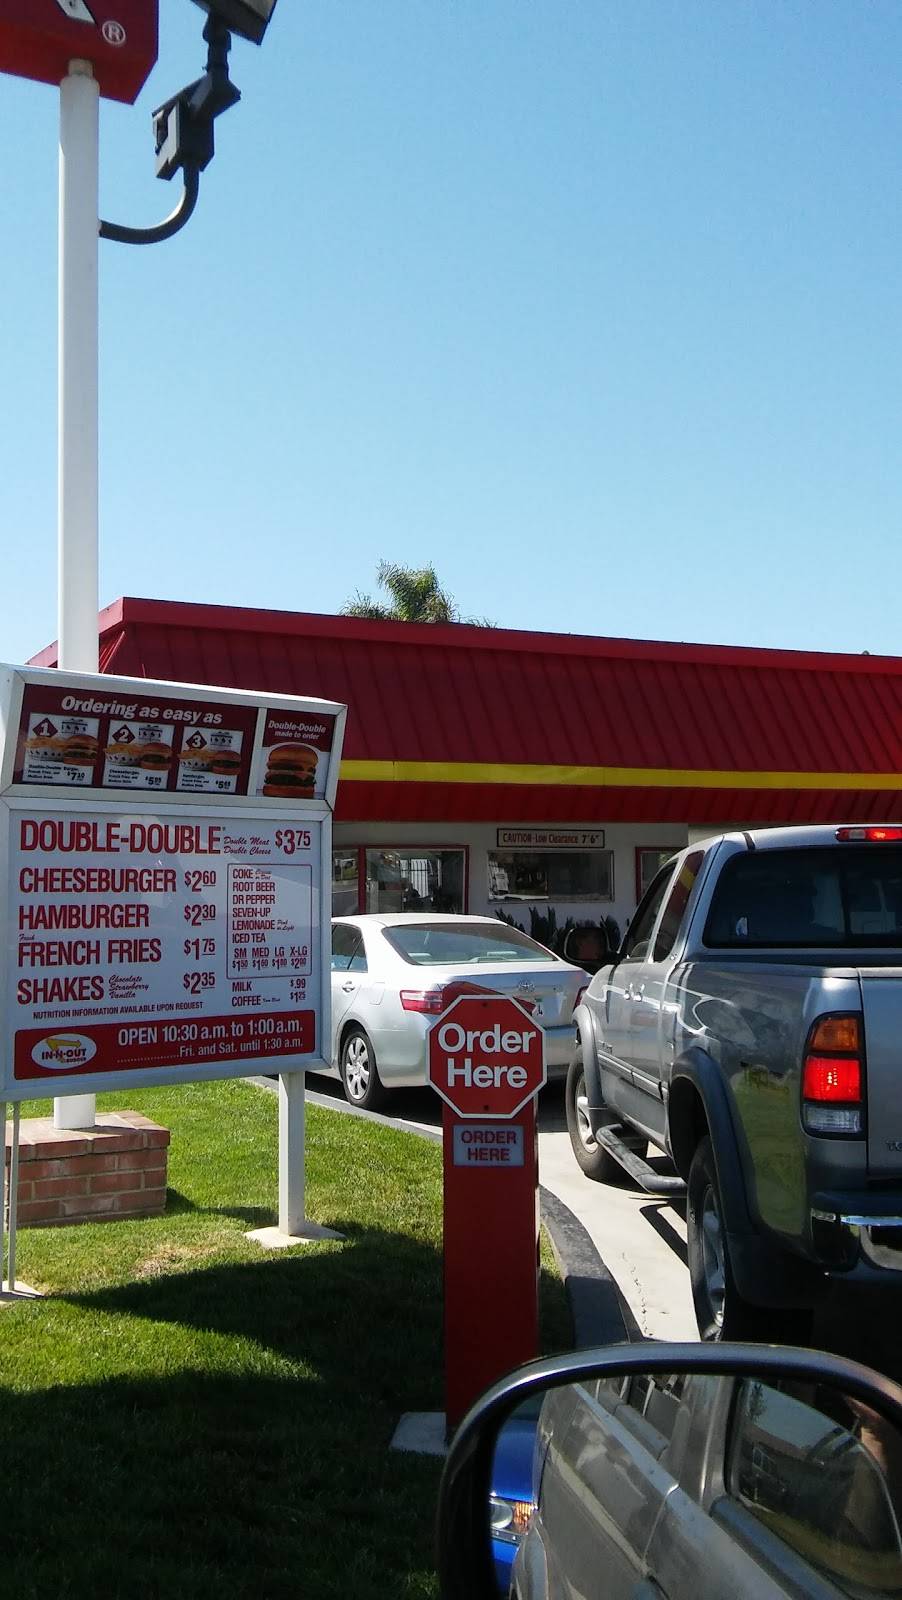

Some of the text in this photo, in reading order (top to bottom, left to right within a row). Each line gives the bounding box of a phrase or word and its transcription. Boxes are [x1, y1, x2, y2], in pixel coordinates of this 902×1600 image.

[61, 696, 222, 724] Ordering as easy as
[40, 722, 49, 736] 1
[268, 720, 327, 733] Double-Double
[118, 729, 129, 742] 2
[192, 735, 201, 748] 3
[20, 820, 221, 854] DOUBLE-DOUBLE
[224, 836, 270, 845] Double Meat
[503, 833, 532, 842] CAUTION
[224, 846, 271, 855] Double Cheese
[20, 867, 176, 893] CHEESEBURGER
[233, 869, 253, 879] COKE
[233, 882, 275, 892] ROOT BEER
[233, 895, 275, 904] DR PEPPER
[19, 904, 149, 930] HAMBURGER
[232, 908, 271, 917] SEVEN-UP
[232, 920, 275, 930] LEMONADE
[232, 933, 266, 943] ICED TEA
[18, 940, 100, 967] FRENCH
[108, 938, 162, 963] FRIES
[234, 946, 308, 958] SM MED LG X-LG
[109, 975, 142, 984] Chocolate
[17, 976, 104, 1005] SHAKES
[232, 981, 252, 992] MILK
[232, 996, 261, 1007] COFFEE
[33, 1001, 203, 1019] NUTRITION INFORMATION AVAILABLE UPON REQUEST
[118, 1018, 303, 1046] OPEN 10:30 a.m. to 1:00 a.m.
[438, 1022, 536, 1054] Order
[198, 1044, 216, 1055] and
[219, 1042, 237, 1054] Sat.
[240, 1040, 260, 1052] until
[264, 1038, 282, 1050] 1:30
[284, 1037, 303, 1048] a.m.
[447, 1058, 528, 1089] Here
[461, 1130, 517, 1144] ORDER
[467, 1147, 510, 1161] HERE
